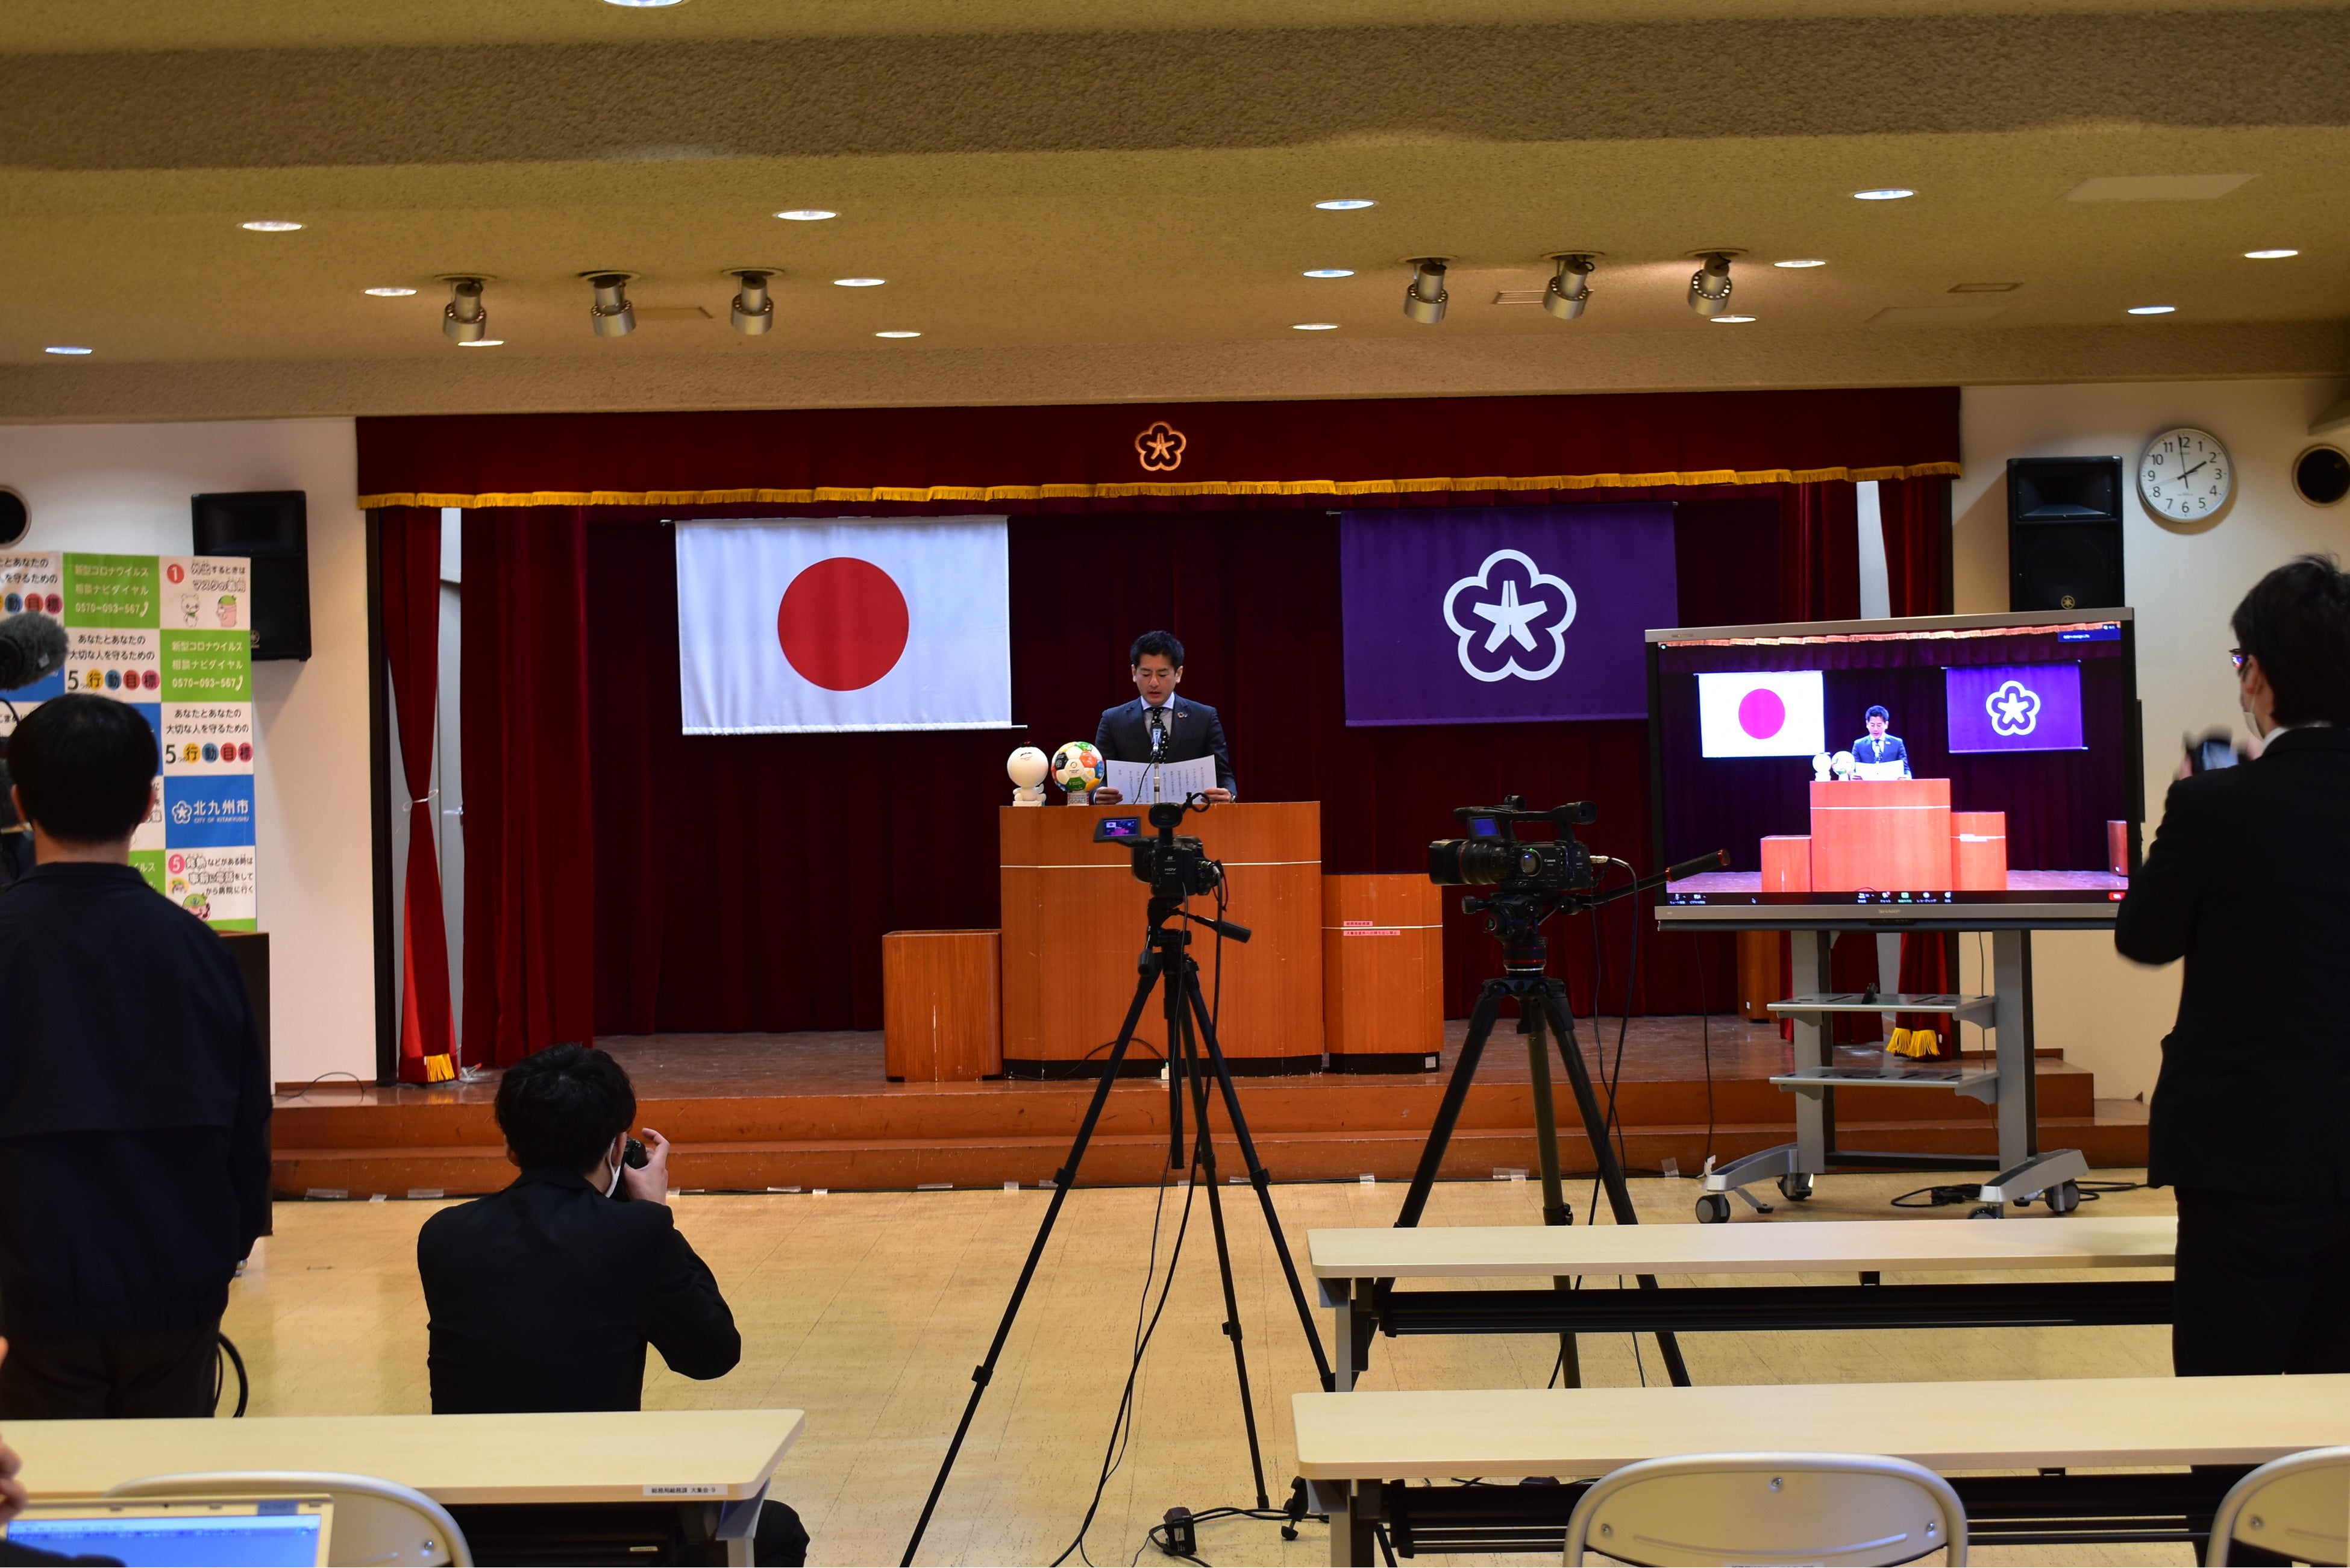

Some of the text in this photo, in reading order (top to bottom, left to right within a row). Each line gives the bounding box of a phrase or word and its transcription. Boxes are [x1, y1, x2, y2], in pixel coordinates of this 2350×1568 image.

[2163, 442, 2173, 452] 11
[2179, 437, 2190, 448] 12
[2198, 441, 2202, 452] 1
[2152, 454, 2164, 465] 10
[2210, 452, 2217, 463] 2
[2148, 470, 2155, 481] 9
[2214, 469, 2222, 479] 3
[2153, 486, 2161, 498] 8
[2210, 486, 2217, 496] 4
[2166, 499, 2173, 509] 7
[2182, 502, 2190, 513] 6
[2199, 498, 2205, 508] 5
[75, 564, 149, 576] 新型コロナウイルス
[0, 573, 58, 584] を守るための
[75, 583, 149, 595] 相談ナビダイヤル
[0, 596, 60, 612] 動目標
[78, 634, 146, 645] あなたとあなたの
[172, 641, 242, 651] 新型コロナウイルス
[69, 650, 155, 660] 大切な人を守るための
[172, 660, 243, 670] 相談ナビダイヤル
[172, 678, 236, 688] 0570-093-567
[175, 708, 242, 718] あなたとあなたの
[166, 724, 249, 734] 大切な人を守るための
[193, 799, 248, 816] 北九州市
